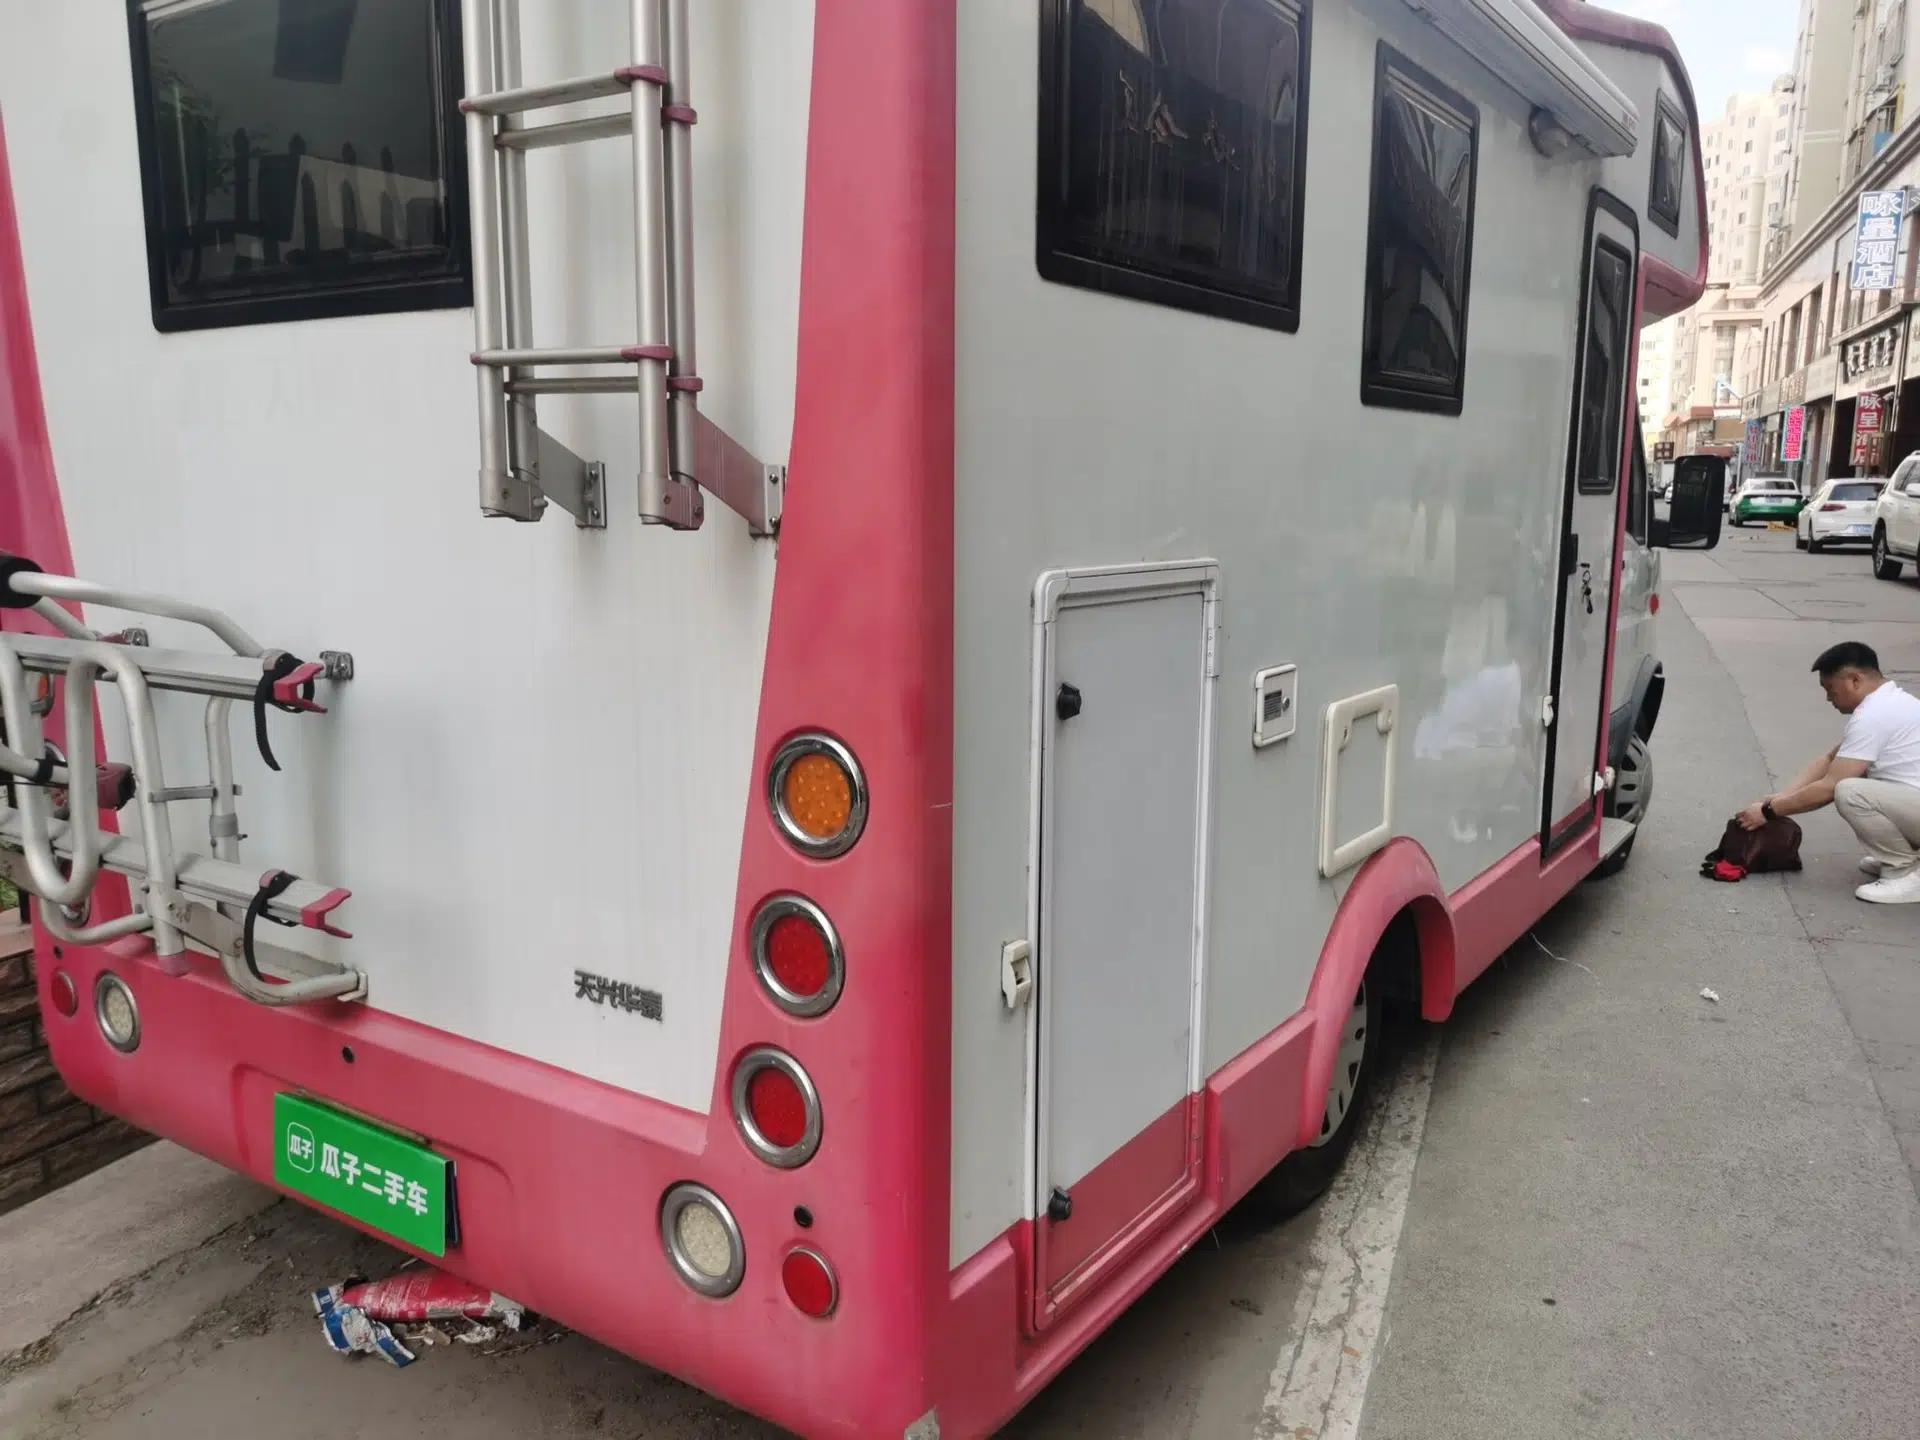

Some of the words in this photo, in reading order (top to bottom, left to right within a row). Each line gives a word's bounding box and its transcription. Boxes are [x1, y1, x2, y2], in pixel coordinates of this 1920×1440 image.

[290, 1134, 312, 1160] 瓜子
[320, 1142, 428, 1216] 瓜子二手车
